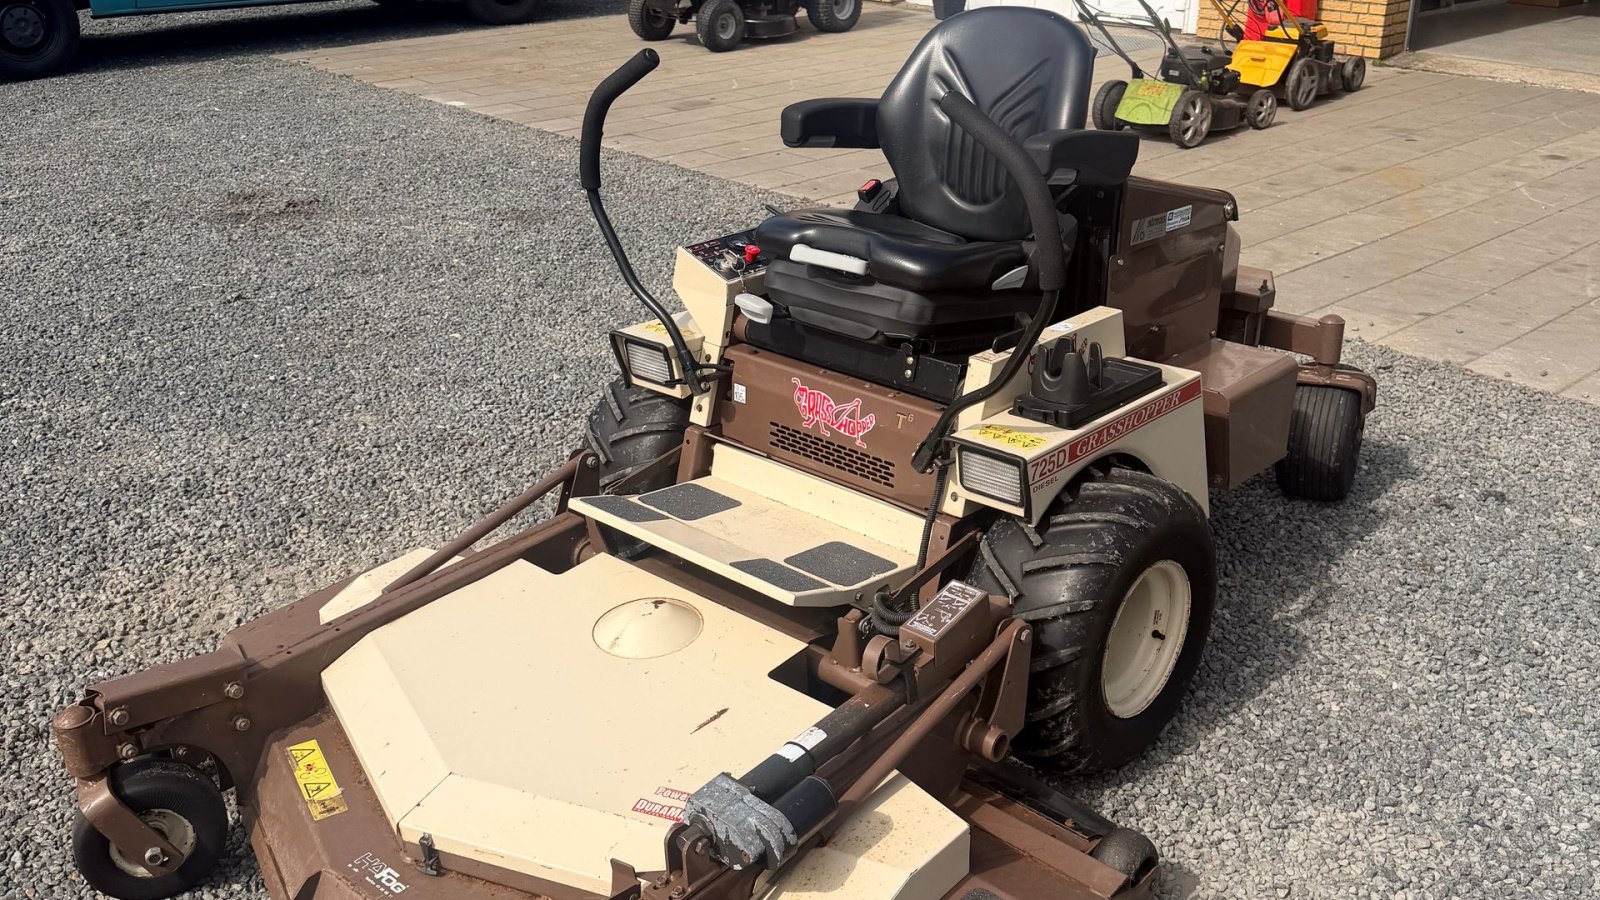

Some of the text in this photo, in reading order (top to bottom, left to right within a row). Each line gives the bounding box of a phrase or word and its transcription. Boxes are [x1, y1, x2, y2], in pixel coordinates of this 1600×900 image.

[1030, 390, 1181, 482] 725D GRASSHOPPER
[1032, 475, 1060, 494] DIESEL
